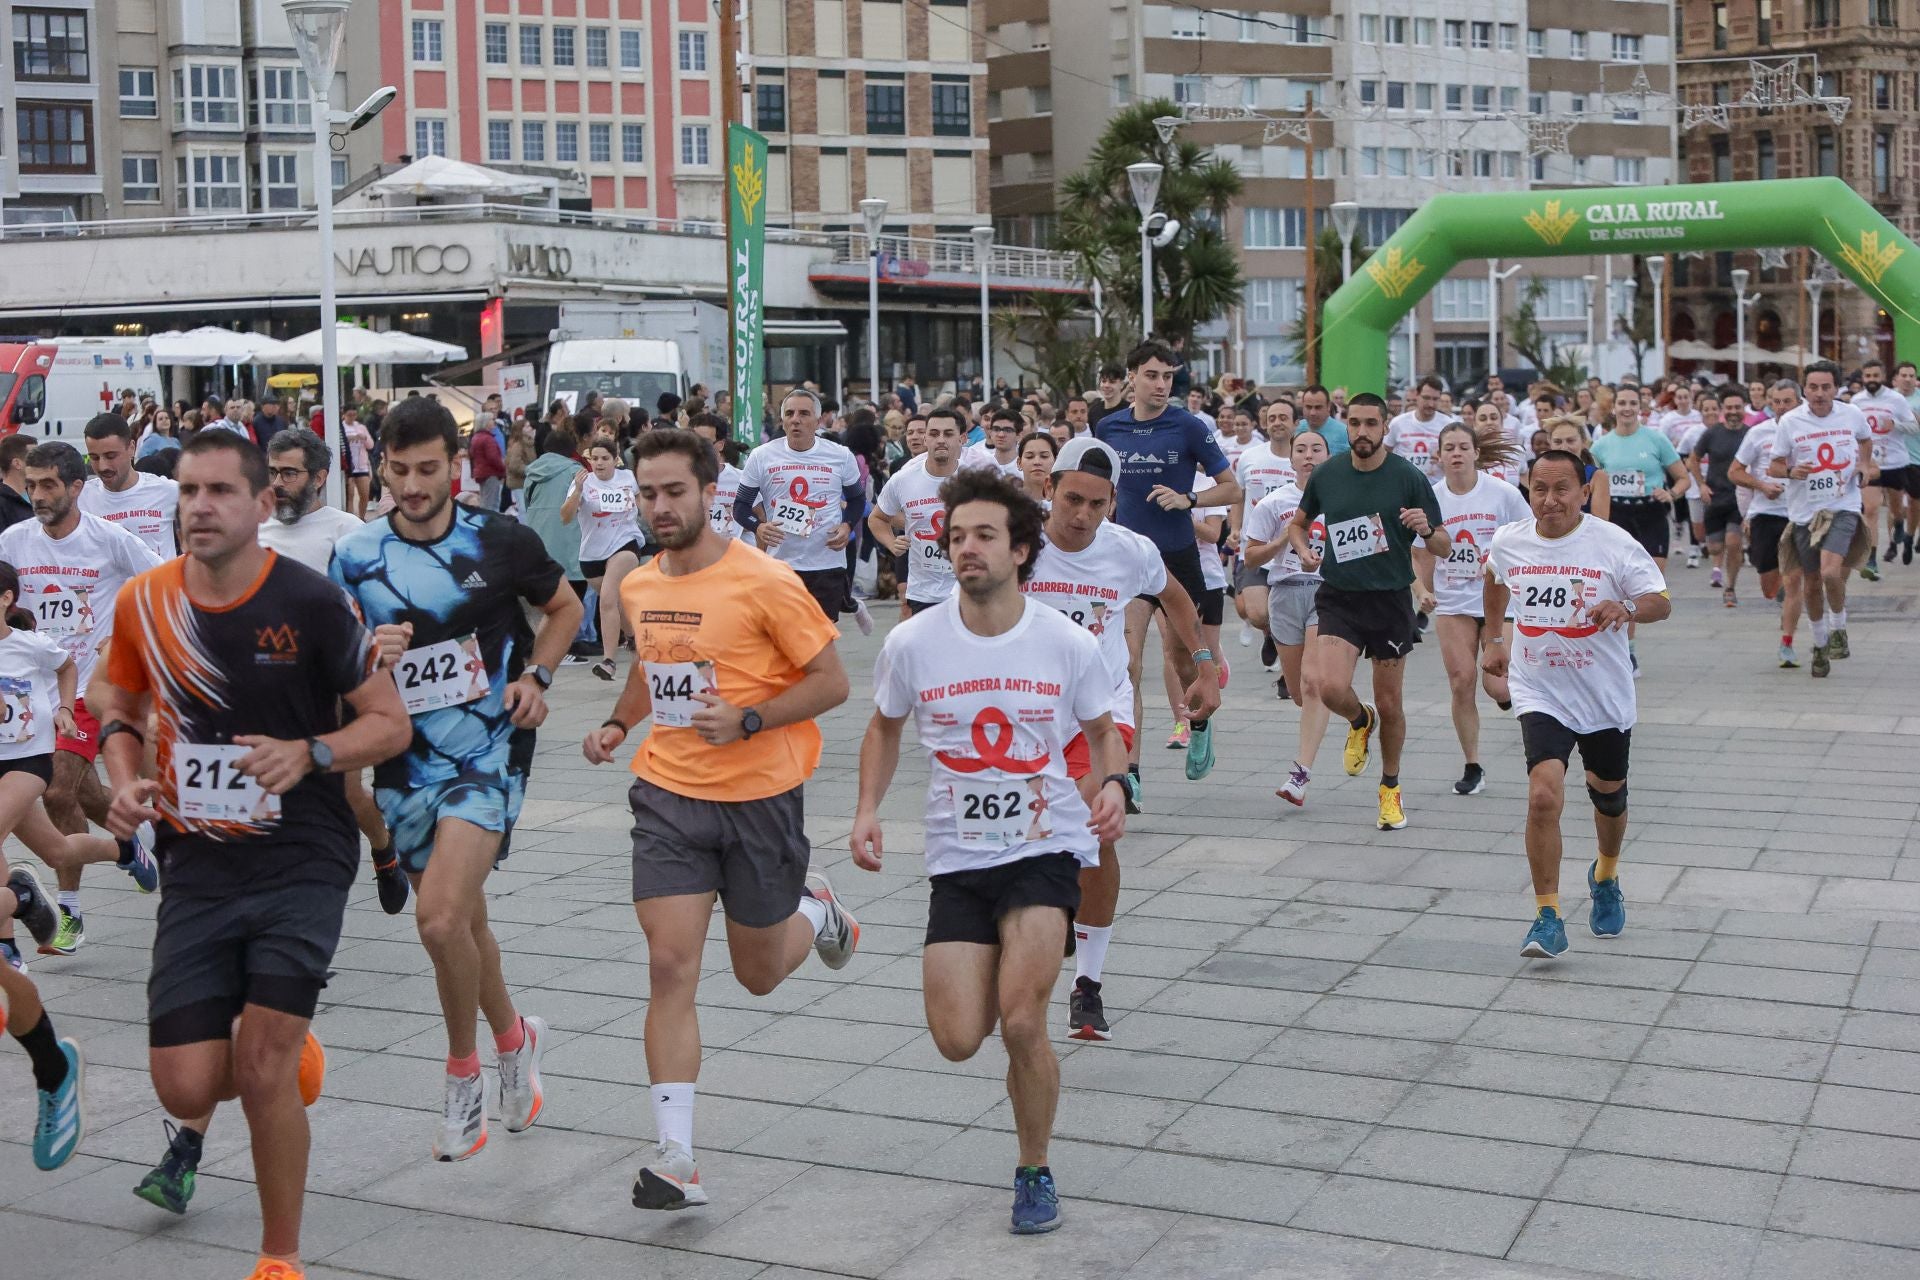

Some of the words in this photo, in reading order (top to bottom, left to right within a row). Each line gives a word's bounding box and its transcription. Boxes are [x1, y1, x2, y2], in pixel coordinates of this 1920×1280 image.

[1586, 203, 1641, 224] CAJA
[1646, 200, 1724, 221] RURAL
[1589, 229, 1609, 241] DE
[1613, 227, 1685, 240] ASTURIAS
[736, 238, 750, 402] RURAL
[1612, 474, 1635, 486] 064
[1809, 477, 1833, 491] 268
[601, 493, 622, 503] 002
[129, 509, 162, 519] ANTI-SIDA
[777, 505, 805, 523] 252
[1336, 524, 1368, 547] 246
[1448, 549, 1475, 563] 245
[30, 566, 60, 575] CARRERA
[62, 567, 99, 578] ANTI-SIDA
[1522, 566, 1557, 575] CARRERA
[1559, 566, 1602, 579] ANTI-SIDA
[1031, 581, 1074, 594] CARRERA
[1075, 583, 1119, 601] ANTI-SIDA
[1525, 586, 1567, 608] 248
[39, 599, 73, 620] 179
[402, 652, 458, 689] 242
[652, 674, 693, 701] 244
[920, 686, 945, 702] XXIV
[948, 678, 1001, 697] CARRERA
[1005, 678, 1061, 697] ANTI-SIDA
[186, 758, 246, 790] 212
[963, 791, 1021, 820] 262
